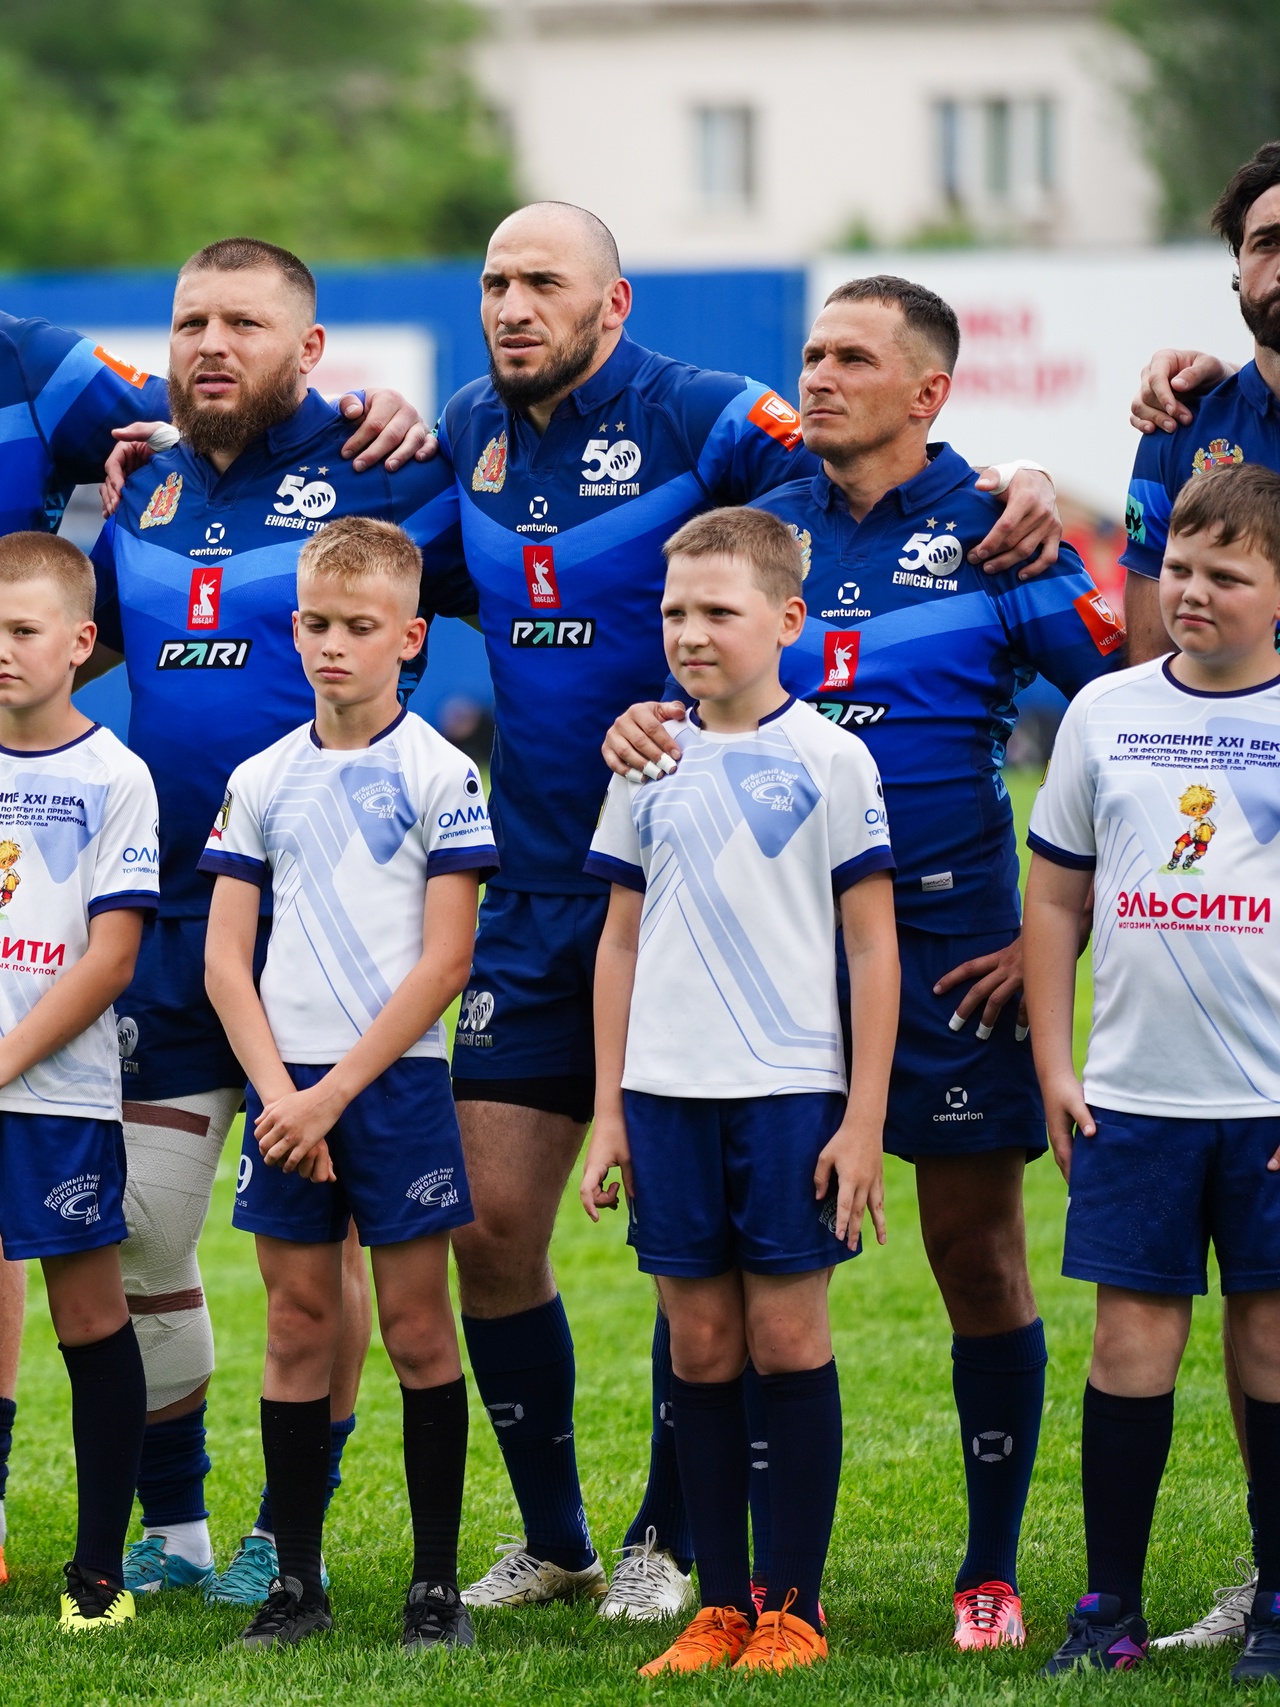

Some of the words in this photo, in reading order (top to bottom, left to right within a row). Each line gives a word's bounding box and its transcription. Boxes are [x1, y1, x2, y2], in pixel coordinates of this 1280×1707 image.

[581, 439, 642, 482] 50
[579, 479, 617, 497] ЕНИСЕЙ
[619, 482, 640, 497] СТМ
[273, 474, 337, 519] 50
[265, 514, 306, 530] ЕНИСЕЙ
[516, 522, 558, 534] centurion
[189, 546, 233, 557] centurion
[898, 532, 963, 577] 50
[892, 571, 934, 589] ЕНИСЕЙ
[935, 577, 958, 592] СТМ
[533, 596, 556, 604] ПОБЕДА!
[192, 616, 214, 625] ПОБЕДА!
[821, 608, 871, 619] centurion
[513, 621, 592, 645] PARI
[159, 642, 248, 667] PARI
[1117, 733, 1214, 747] ПОКОЛЕНИЕ
[1217, 736, 1244, 748] XXI
[1173, 756, 1209, 764] ТРЕНЕРА
[1247, 752, 1276, 760] ПРИЗЫ
[744, 775, 795, 793] ПОКОЛЕНИЕ
[23, 793, 47, 805] XXI
[51, 795, 85, 810] ВЕКА
[771, 803, 793, 812] ВЕКА
[438, 826, 480, 841] ТОПЛИВНАЯ
[1117, 891, 1271, 923] ЭЛЬСИТИ
[1118, 921, 1151, 930] магазин
[1153, 921, 1211, 932] любимых
[1214, 923, 1264, 935] покупок
[12, 963, 57, 976] покупок
[933, 1110, 984, 1122] centurion
[43, 1174, 85, 1208] регбийный
[411, 1174, 453, 1201] ПОКОЛЕНИЕ
[50, 1181, 99, 1211] ПОКОЛЕНИЕ
[440, 1197, 459, 1208] ВЕКА
